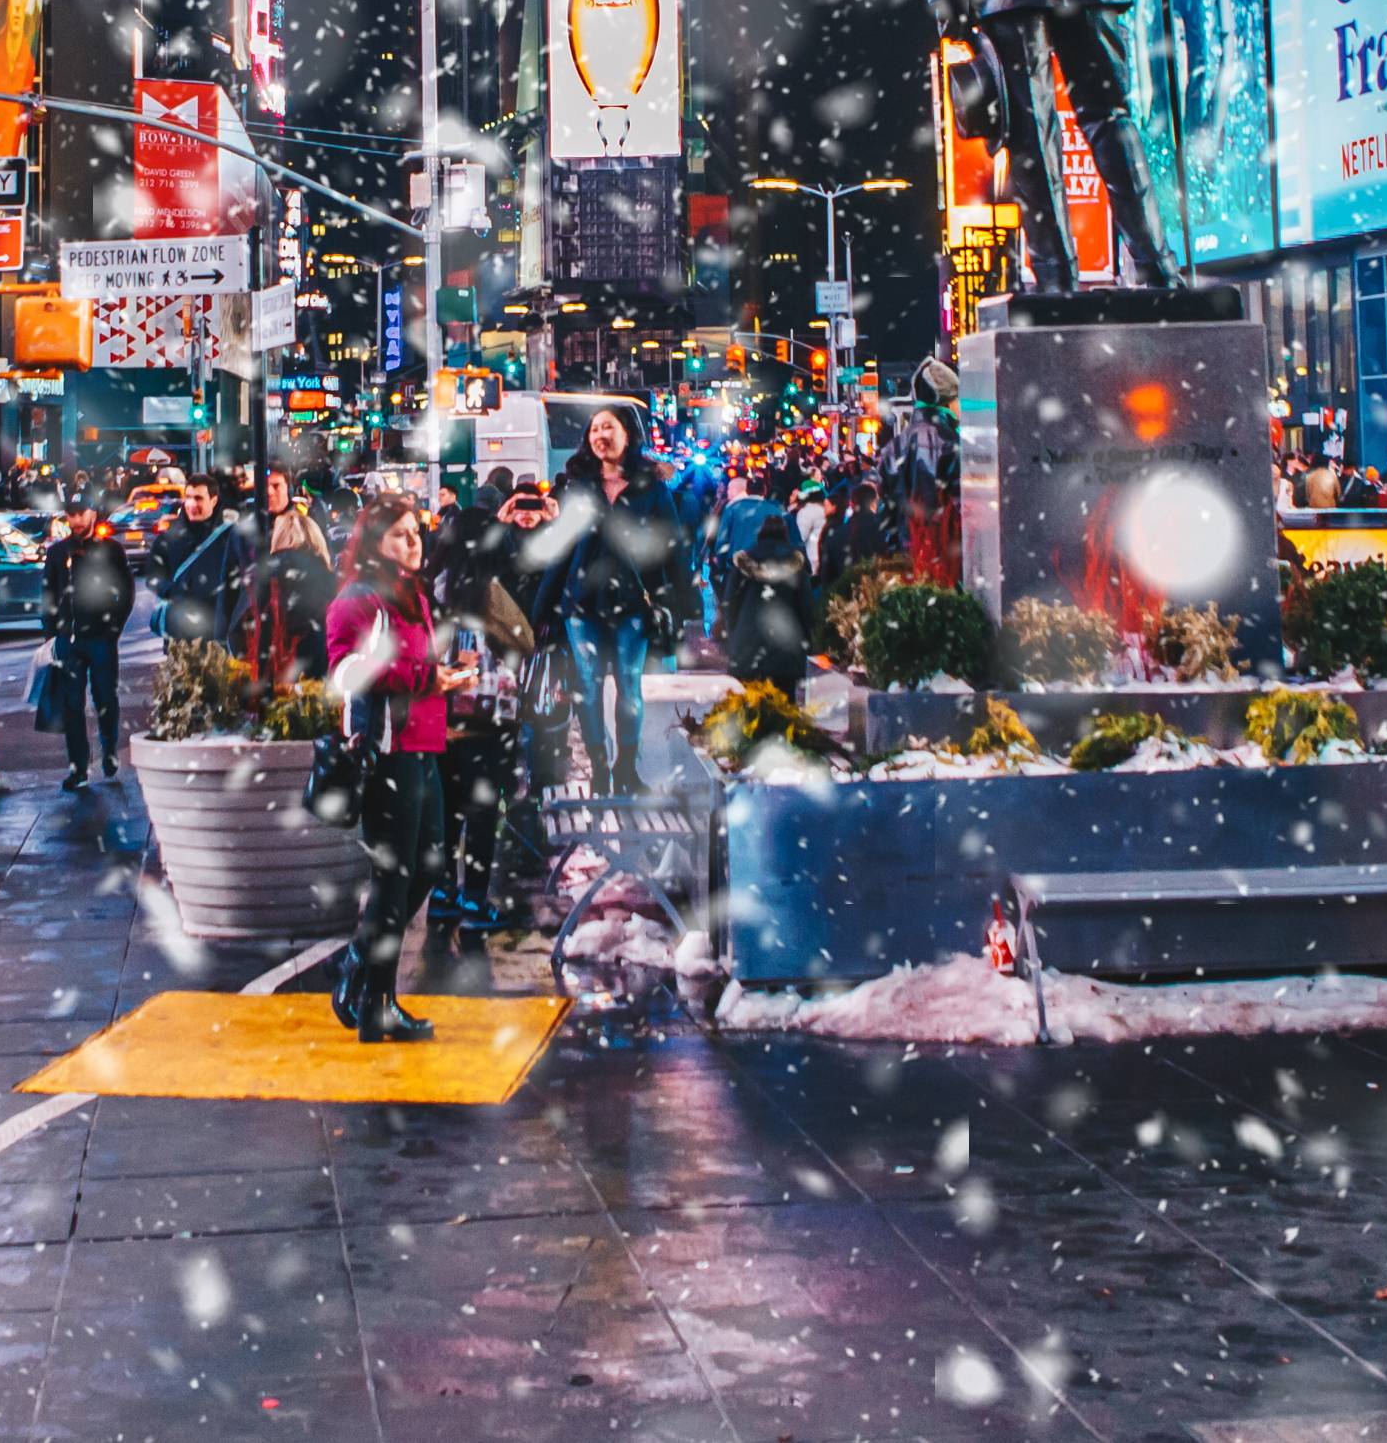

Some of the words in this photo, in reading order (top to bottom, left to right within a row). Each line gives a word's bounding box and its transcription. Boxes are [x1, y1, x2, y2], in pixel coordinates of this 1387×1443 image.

[144, 169, 167, 178] DAVID
[169, 169, 196, 178] GREEN
[159, 179, 174, 188] 716
[69, 248, 148, 268] PEDESTRIAN
[153, 247, 187, 264] FLOW
[192, 245, 226, 262] ZONE
[105, 271, 155, 289] MOVING
